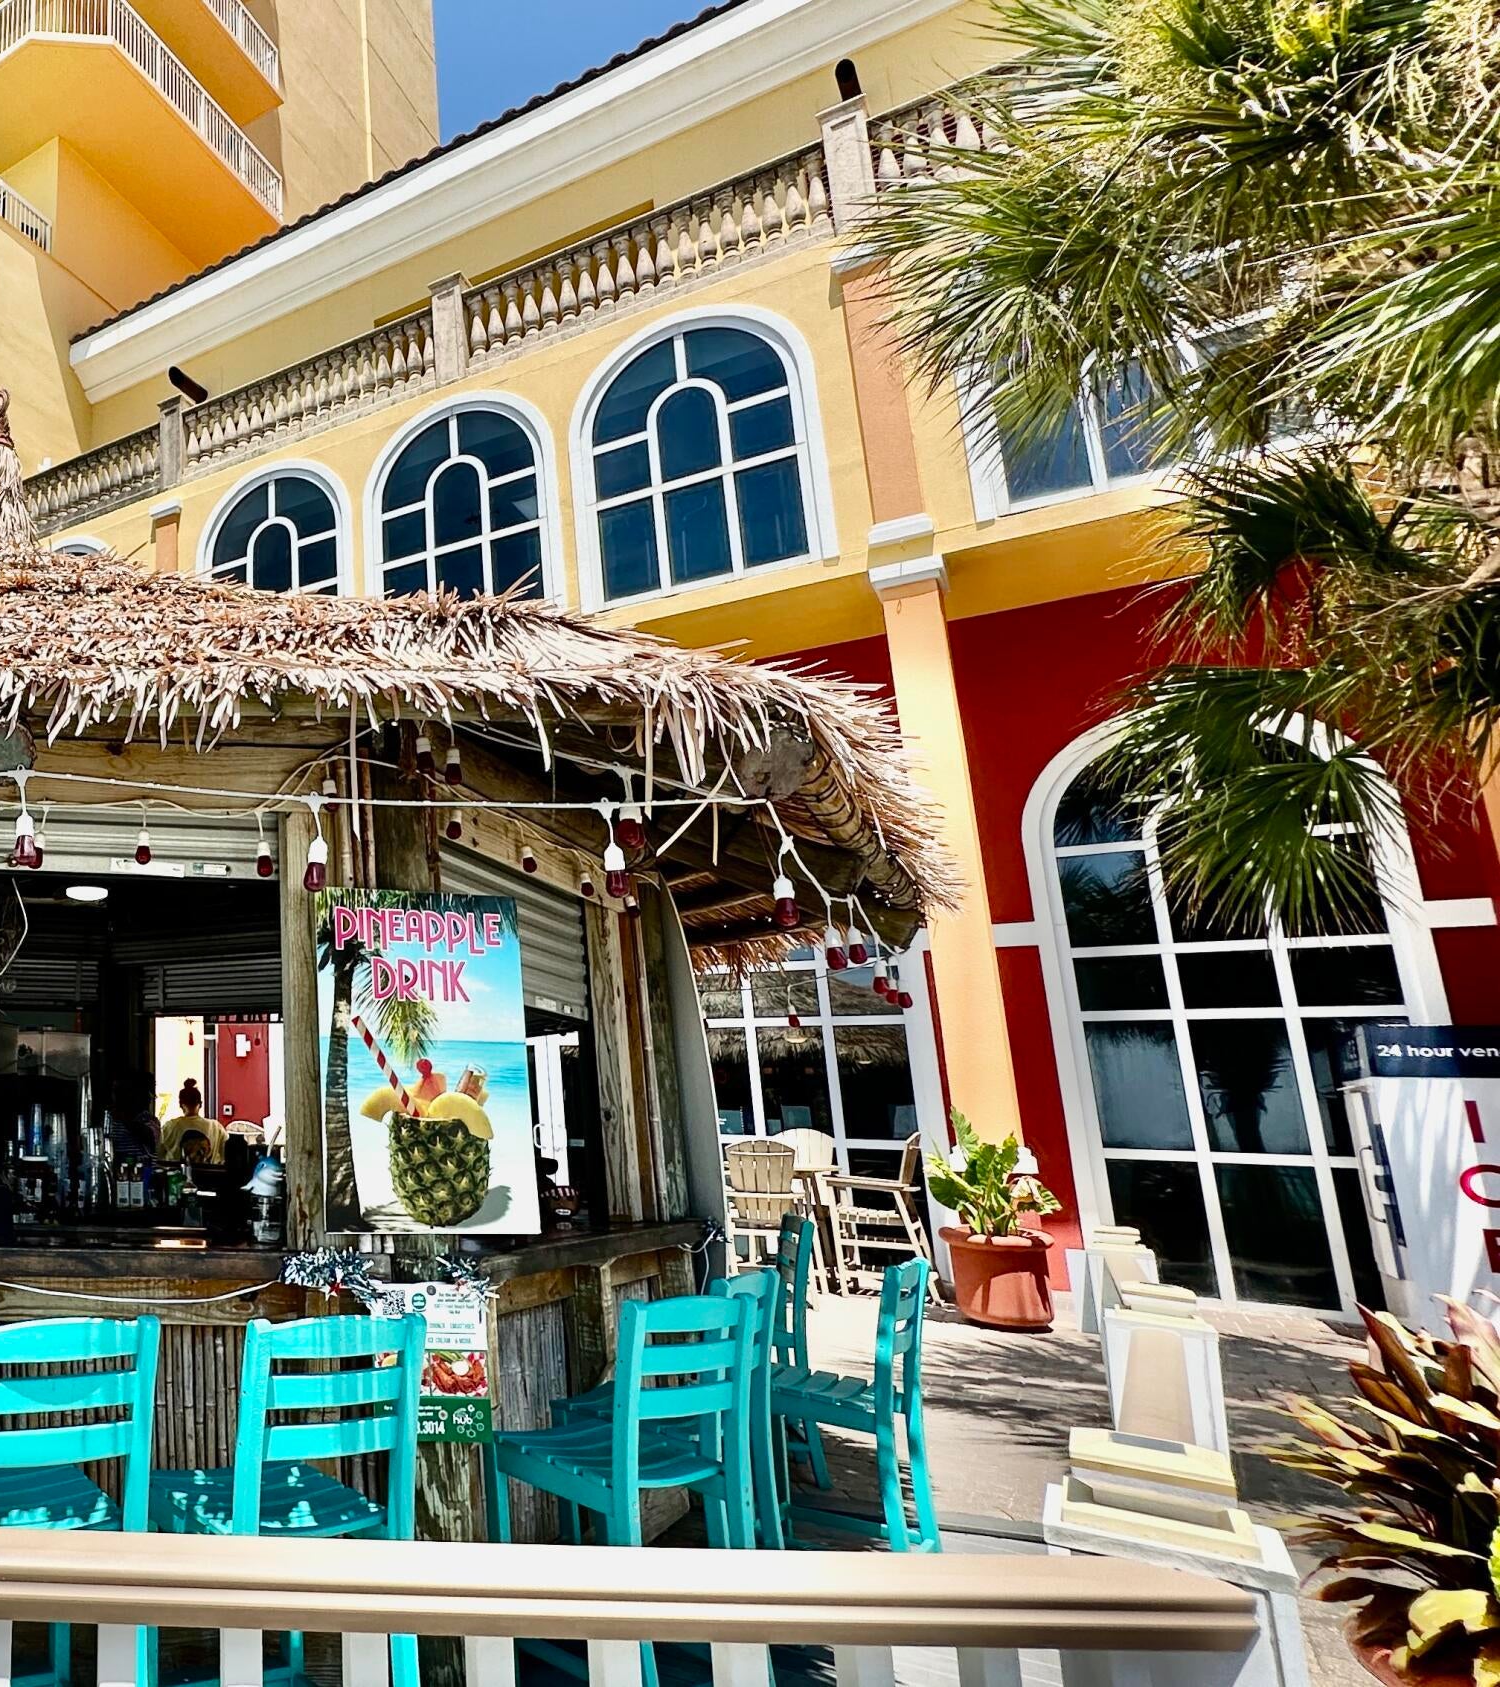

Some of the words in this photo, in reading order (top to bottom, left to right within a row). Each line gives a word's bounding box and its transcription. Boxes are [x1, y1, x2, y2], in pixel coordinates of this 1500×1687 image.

[335, 906, 501, 955] PINEAPPLE
[372, 957, 471, 1003] DRINK
[1377, 1044, 1402, 1057] 24
[1406, 1044, 1454, 1058] hour
[1458, 1047, 1500, 1057] ven
[452, 1413, 473, 1425] hub
